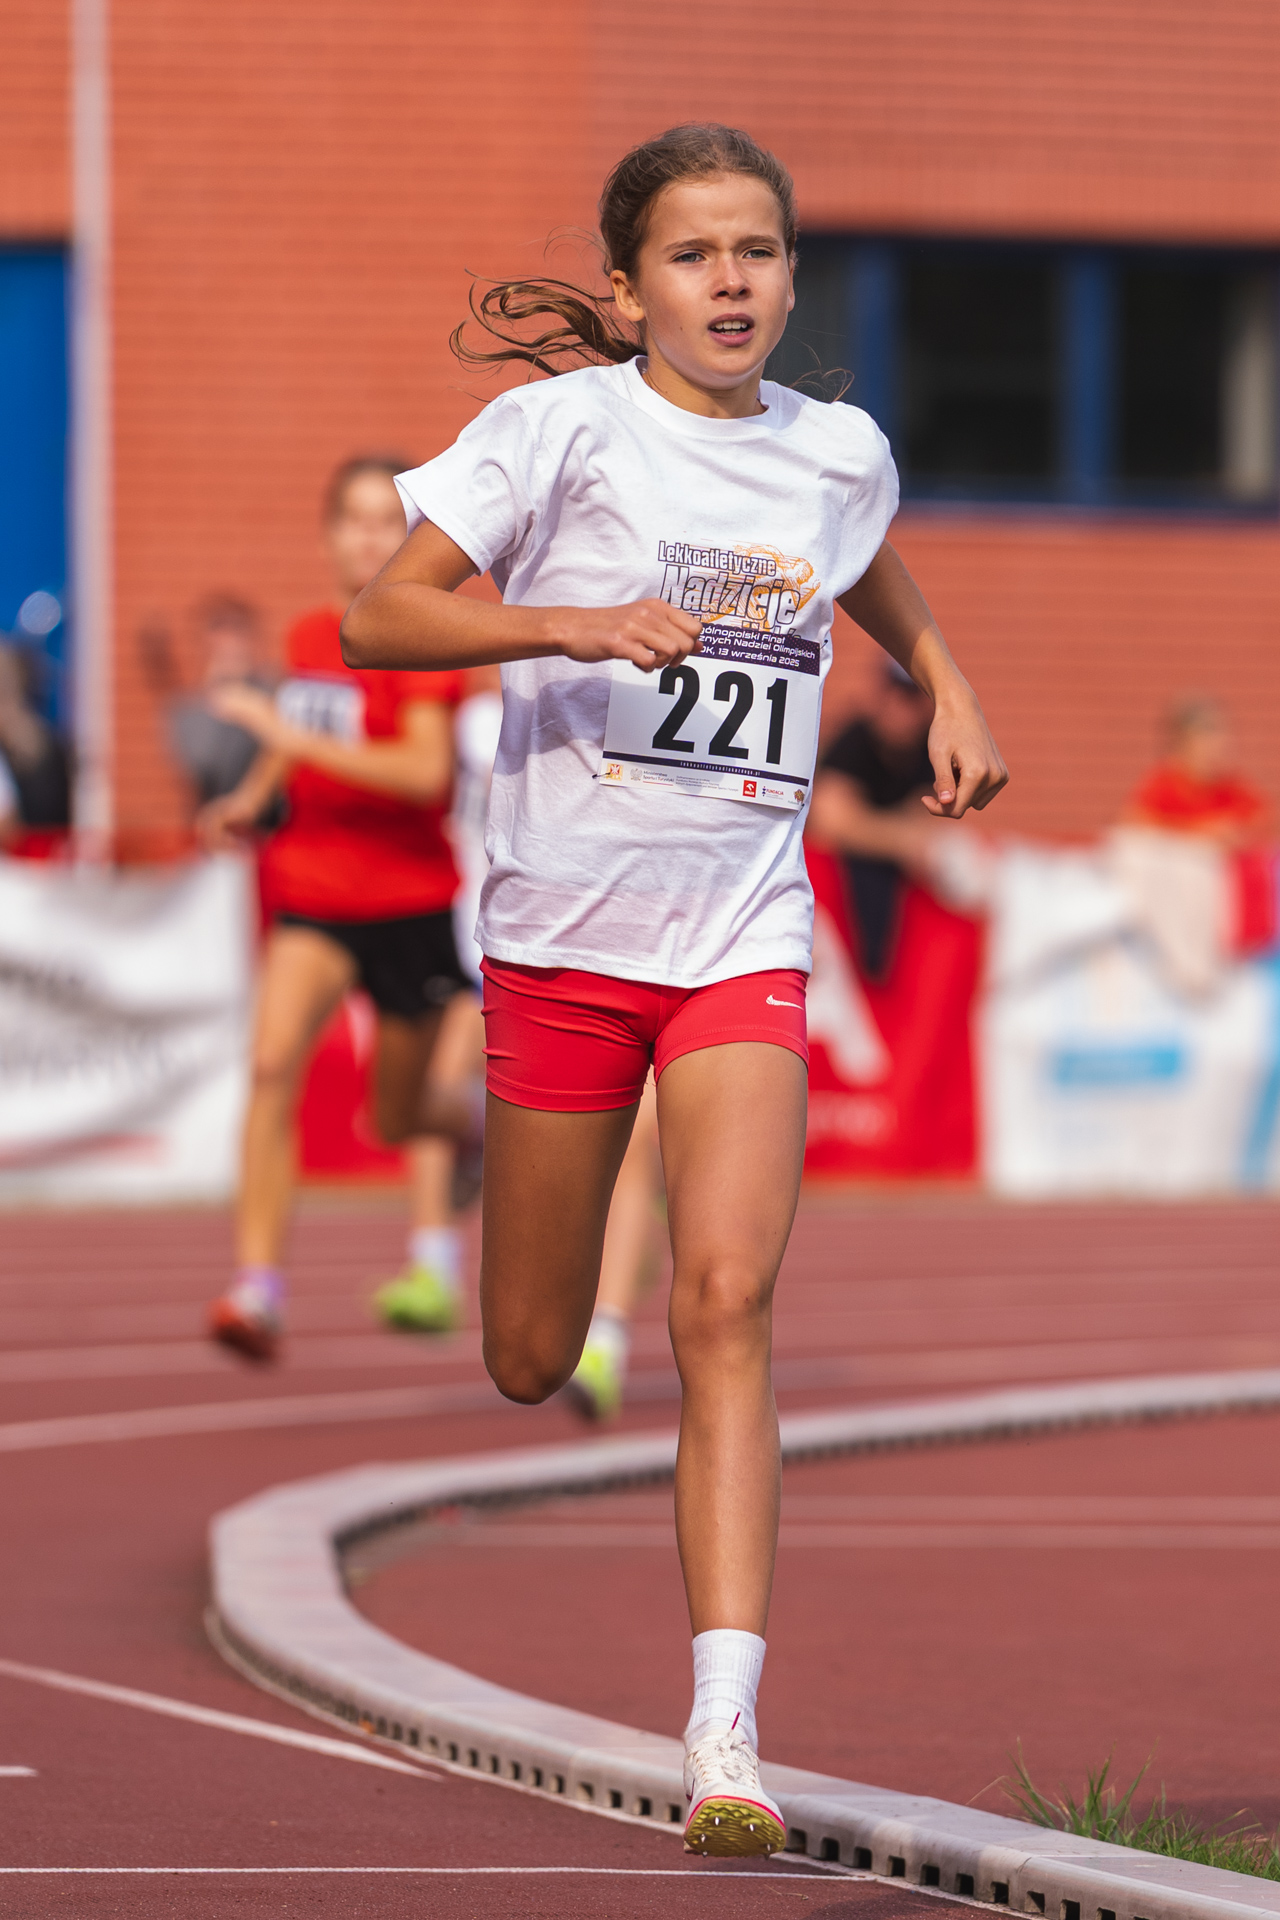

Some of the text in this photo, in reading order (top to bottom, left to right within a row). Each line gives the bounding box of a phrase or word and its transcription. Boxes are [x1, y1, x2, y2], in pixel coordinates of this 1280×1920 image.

[658, 540, 776, 577] Lekkoatletyczne
[660, 564, 800, 629] Nadzieje
[700, 626, 760, 640] gólnopolski
[718, 647, 729, 656] 13
[731, 650, 778, 663] września
[778, 656, 800, 667] 2025
[773, 643, 816, 660] Olimpijskich
[652, 664, 789, 766] 221
